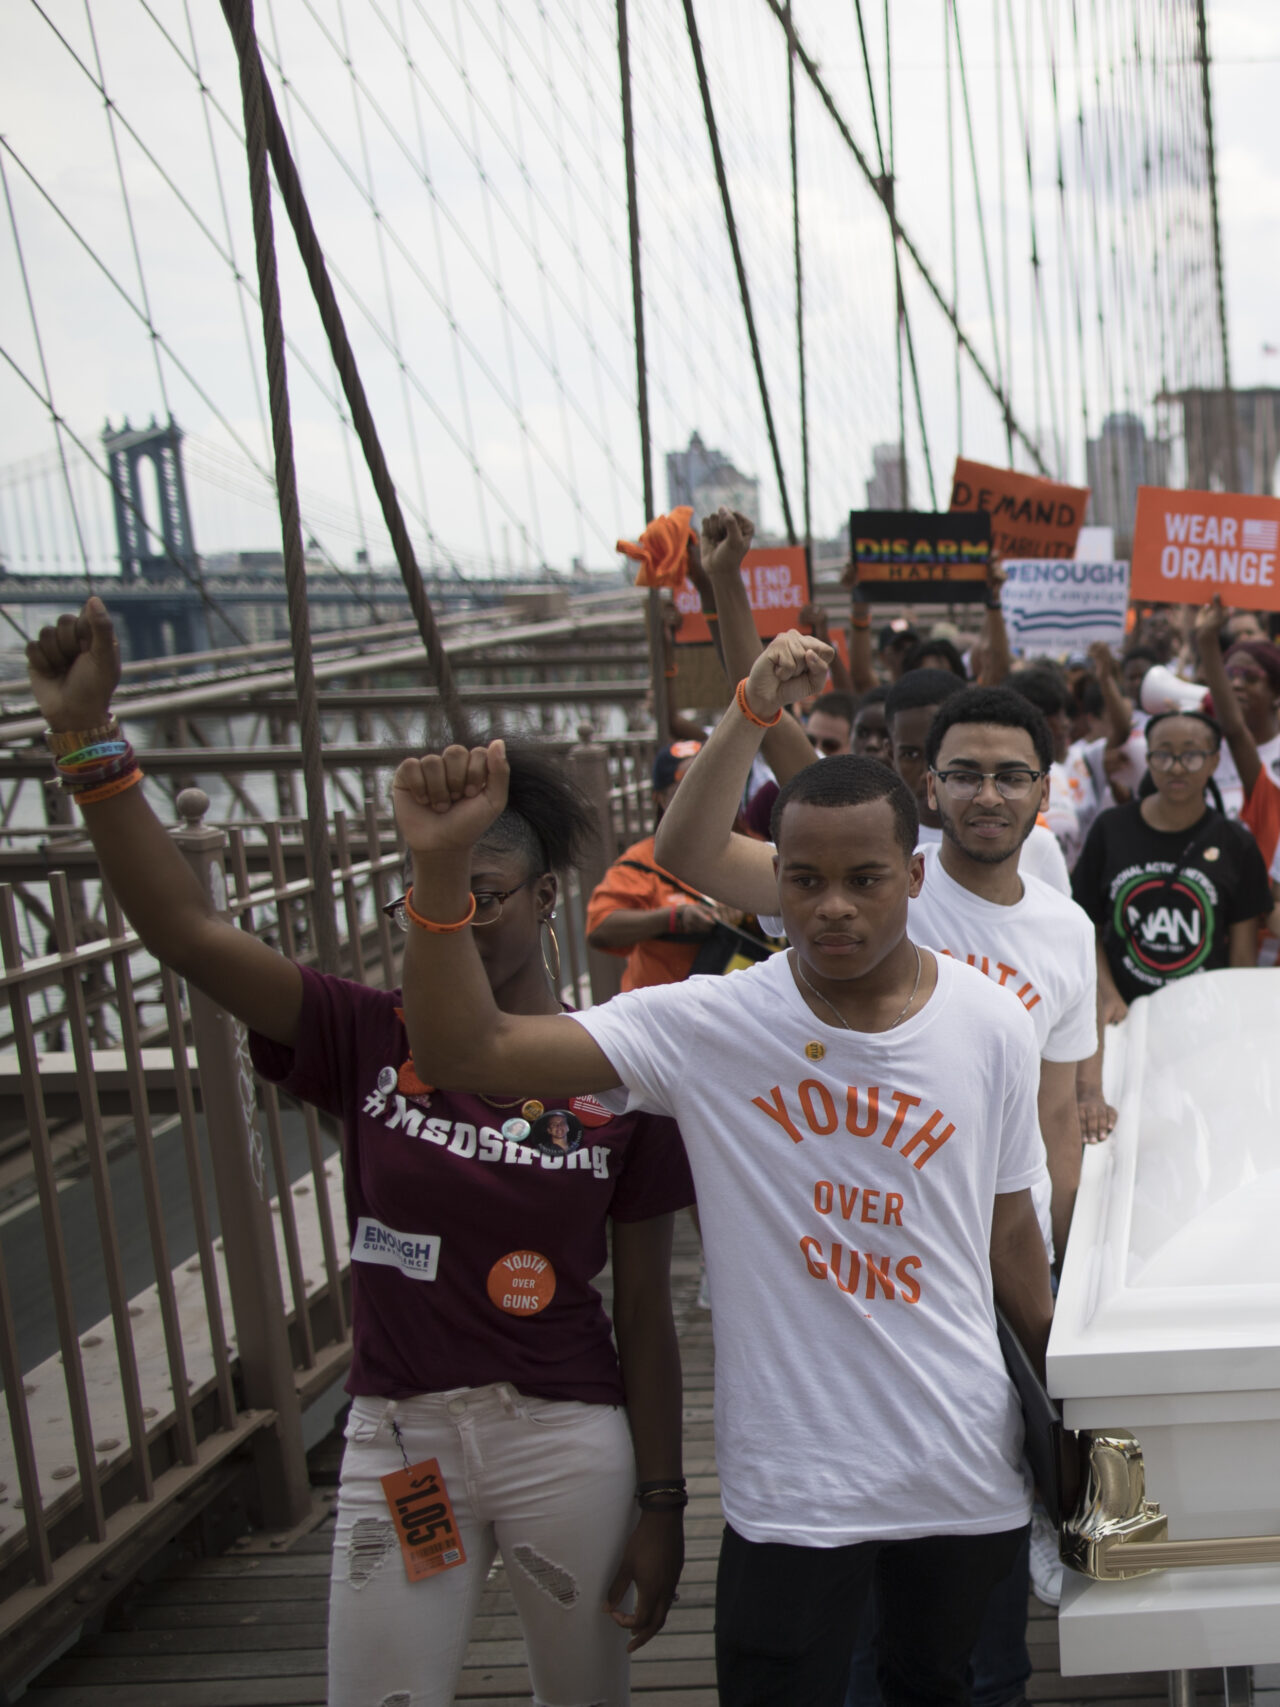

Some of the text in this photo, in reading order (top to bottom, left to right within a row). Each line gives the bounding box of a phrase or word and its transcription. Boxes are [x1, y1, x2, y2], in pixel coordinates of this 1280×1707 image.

[951, 479, 1077, 529] DEMAND
[1163, 510, 1239, 548] WEAR
[855, 537, 990, 564] DISARM
[754, 564, 793, 589] END
[888, 566, 953, 580] HATE
[1005, 563, 1126, 584] #ENOUGH
[1159, 544, 1277, 587] ORANGE
[676, 592, 701, 615] GU
[750, 1078, 957, 1171] YOUTH
[814, 1180, 904, 1227] OVER
[362, 1242, 386, 1252] GUN
[364, 1225, 432, 1261] ENOUGH
[502, 1253, 548, 1275] YOUTH
[799, 1234, 923, 1305] GUNS
[511, 1277, 536, 1290] OVER
[502, 1293, 540, 1311] GUNS
[395, 1474, 453, 1547] $1.05
